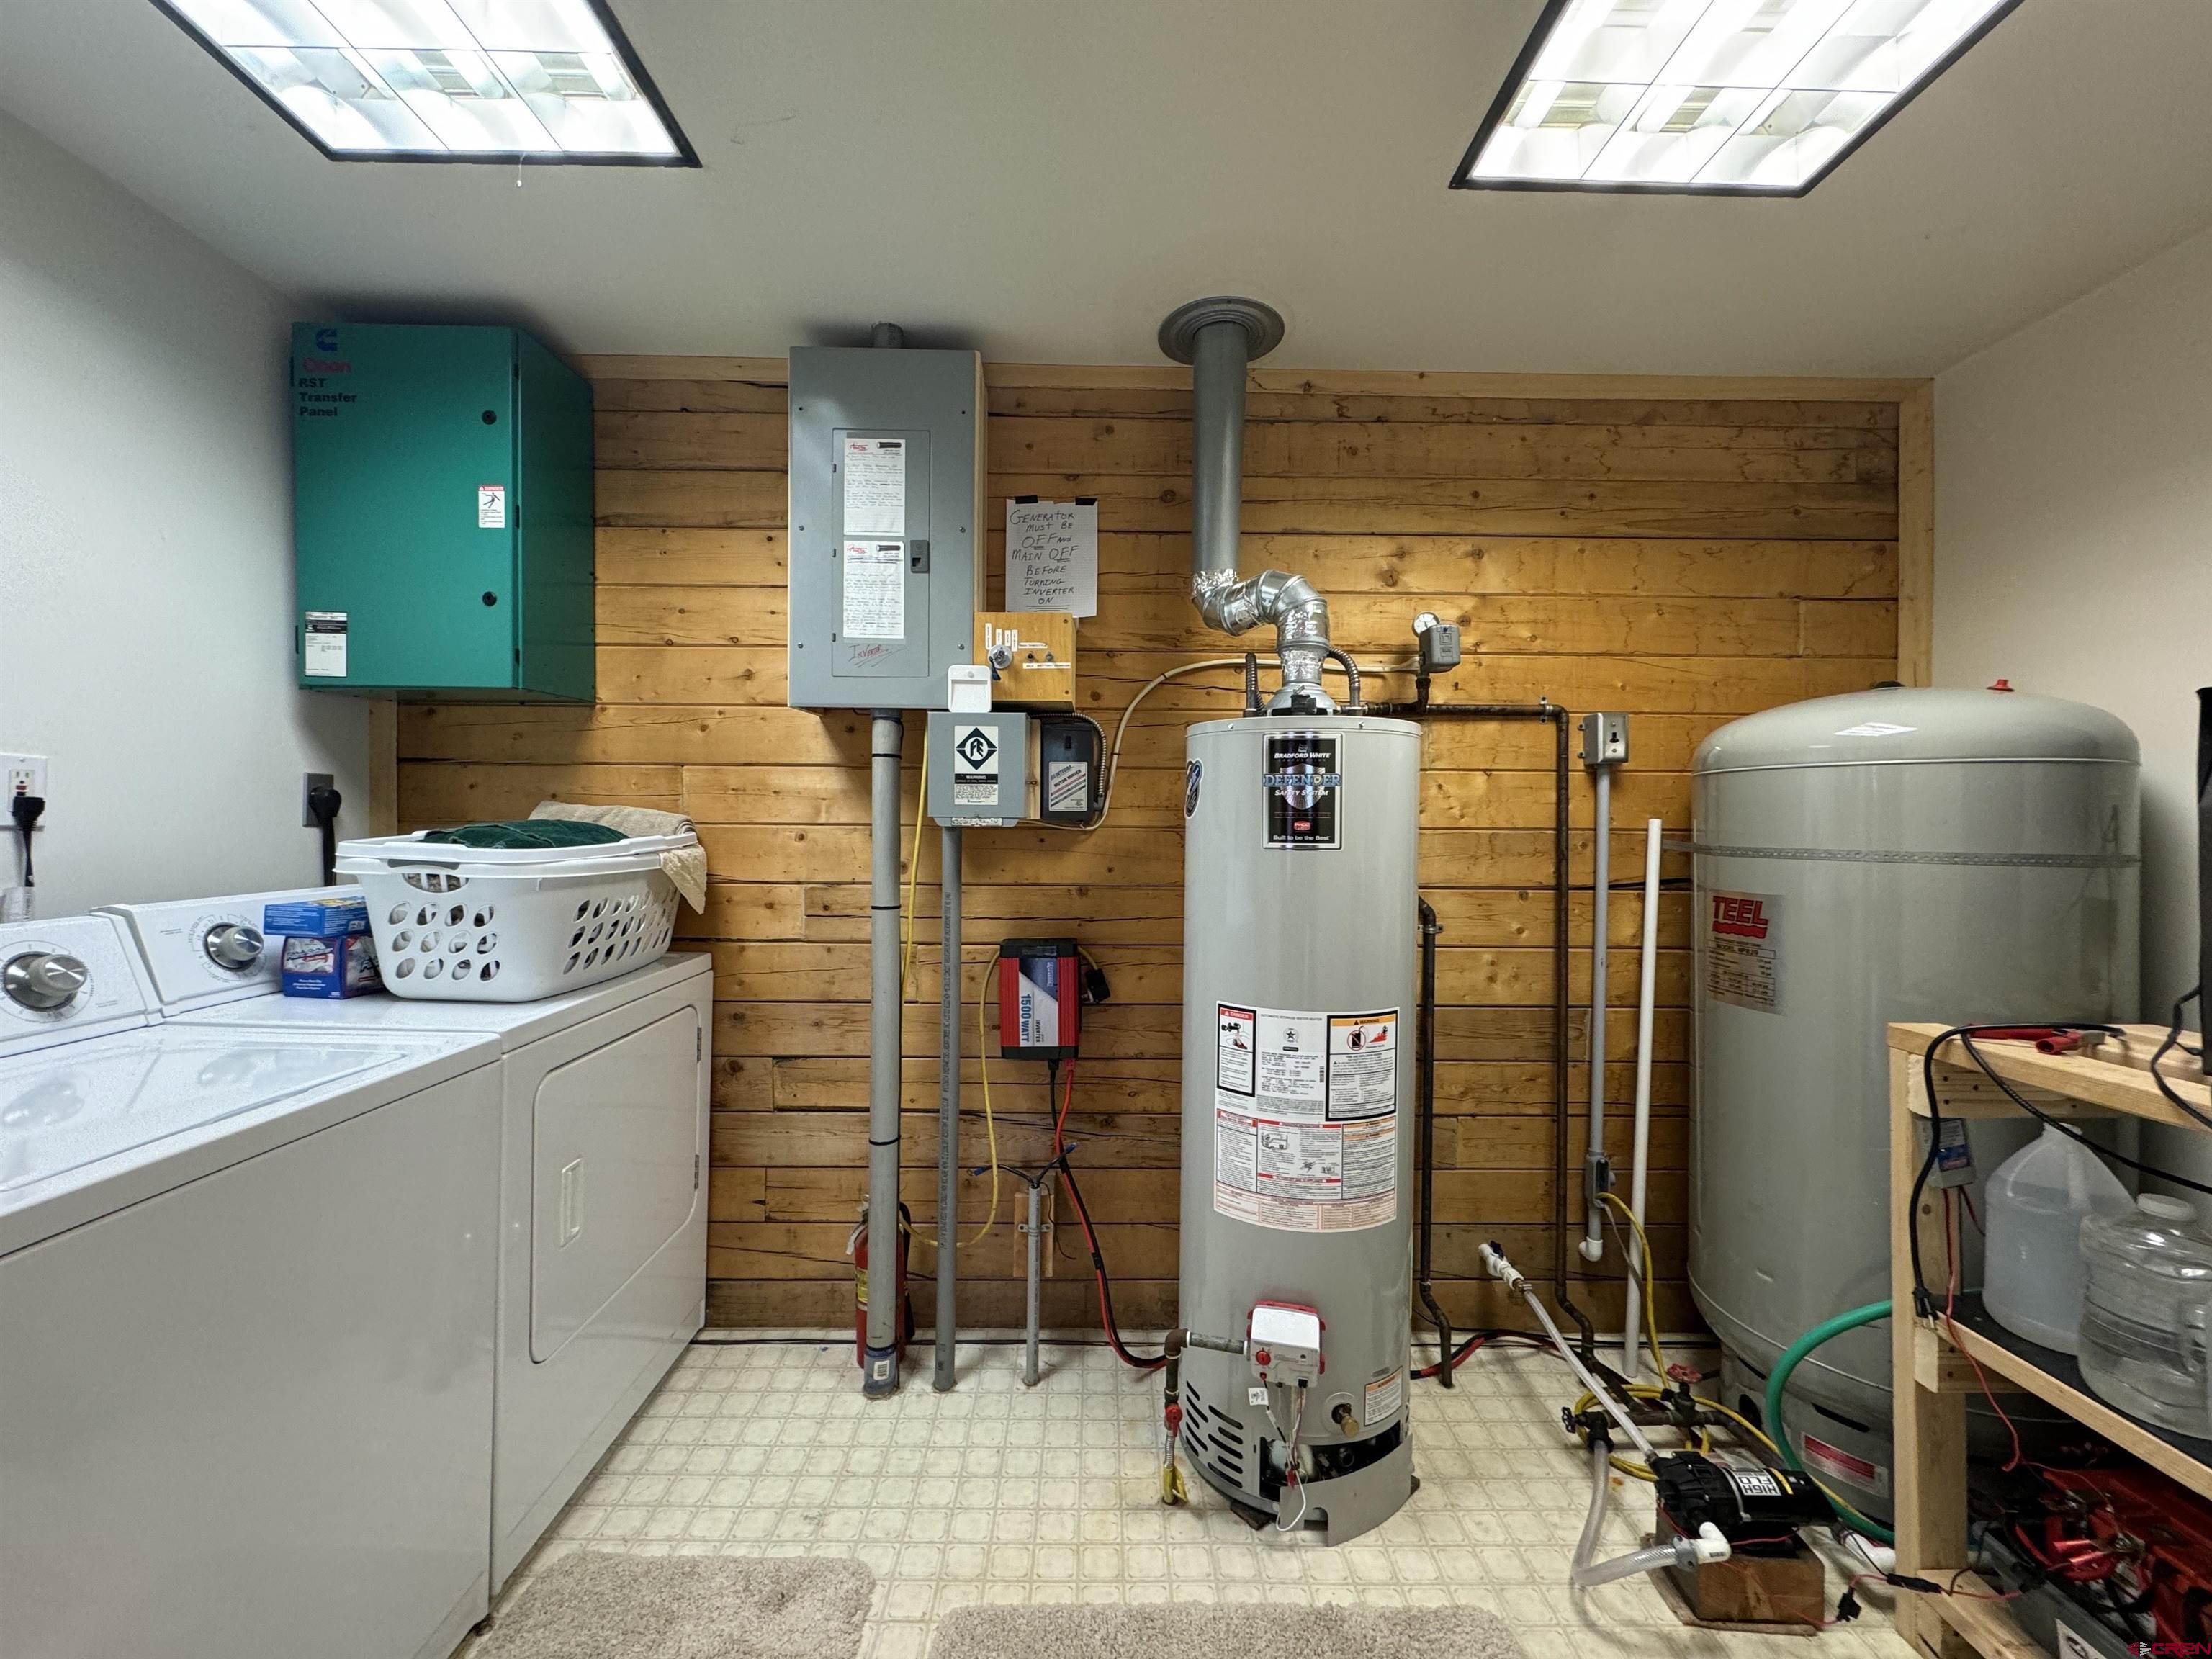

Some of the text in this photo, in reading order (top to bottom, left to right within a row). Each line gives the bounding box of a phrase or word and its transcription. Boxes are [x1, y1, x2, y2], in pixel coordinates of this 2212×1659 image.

[299, 377, 328, 387] RST
[300, 392, 357, 403] Transfer
[300, 406, 338, 416] Panel
[1025, 521, 1073, 533] MUST BE
[1022, 532, 1059, 549] OFF
[1011, 545, 1079, 562] MAIN OFF
[1026, 565, 1066, 577] BEFORE
[1024, 577, 1065, 587] TURNING
[1023, 587, 1074, 595] INVERTER
[1264, 774, 1341, 786] DEFENDER
[1712, 896, 1769, 926] TEEL
[1021, 994, 1032, 1019] 1500
[1738, 1476, 1773, 1485] FLO
[1743, 1485, 1779, 1494] HIGH
